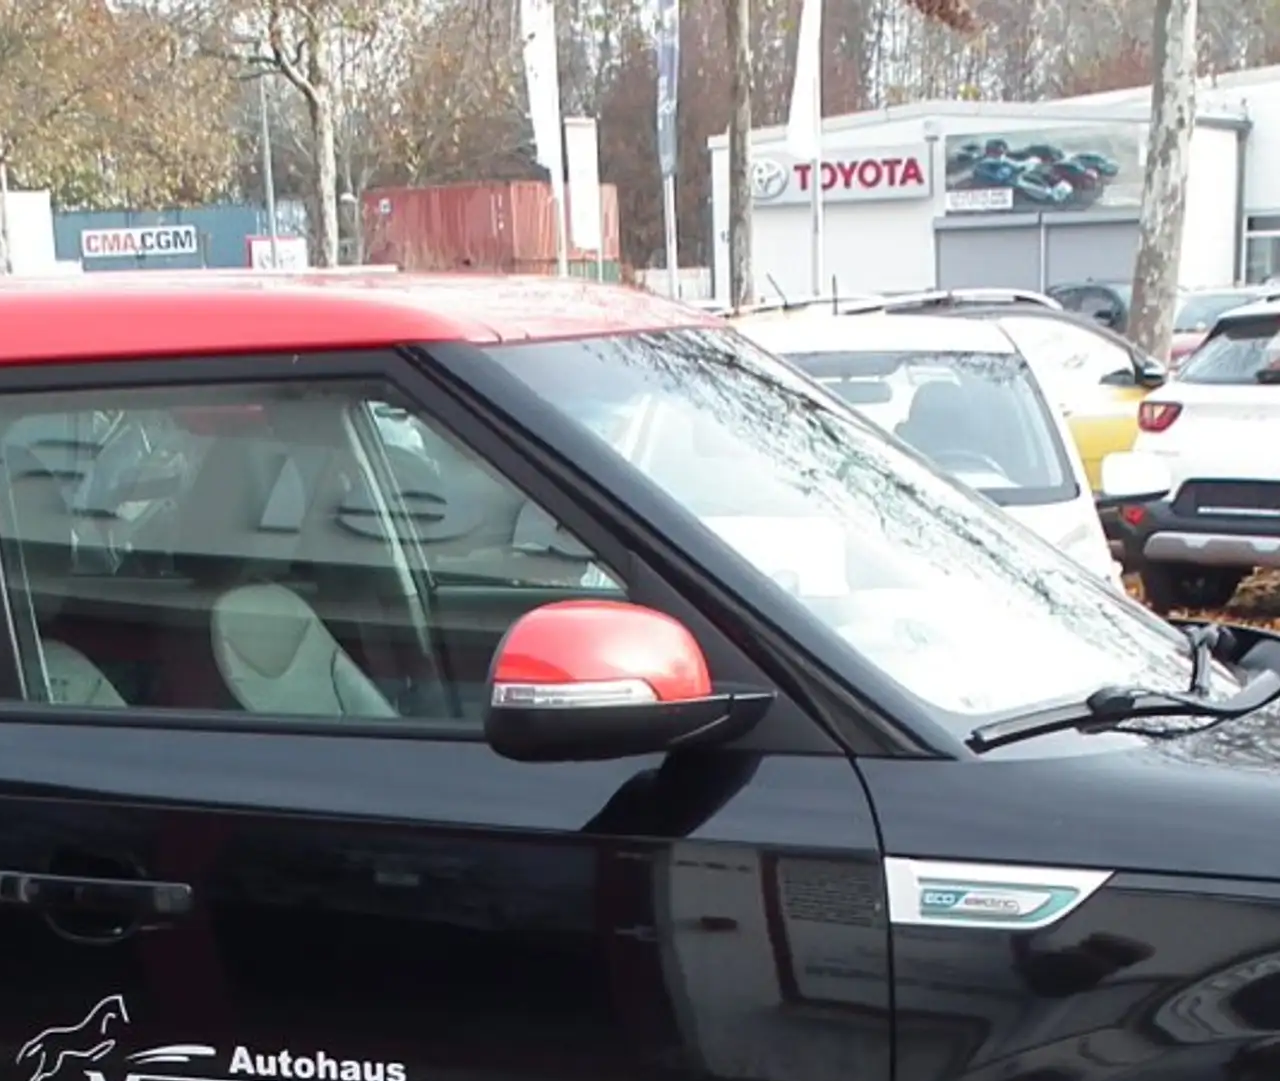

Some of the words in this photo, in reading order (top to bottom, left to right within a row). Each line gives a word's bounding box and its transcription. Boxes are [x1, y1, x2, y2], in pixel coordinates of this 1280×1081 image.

[793, 157, 925, 191] TOYOTA
[86, 233, 137, 252] CMA
[140, 230, 193, 250] CGM
